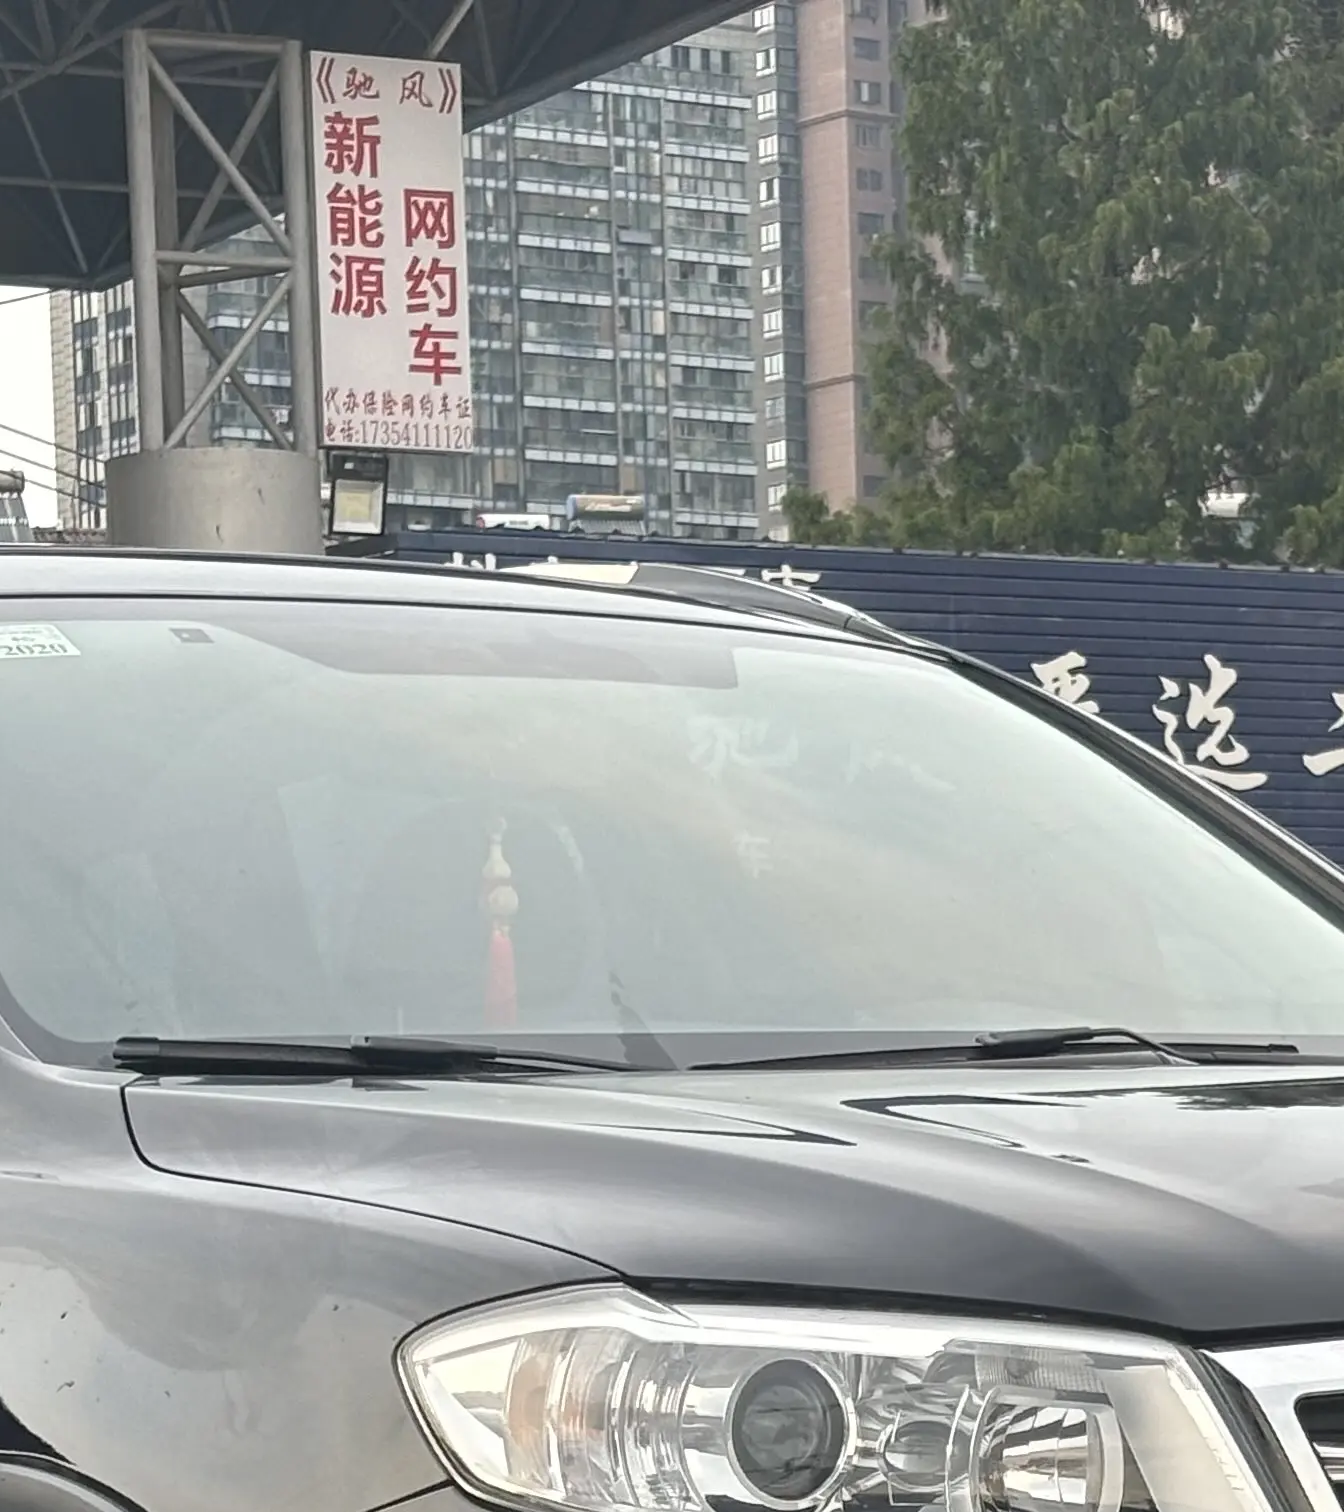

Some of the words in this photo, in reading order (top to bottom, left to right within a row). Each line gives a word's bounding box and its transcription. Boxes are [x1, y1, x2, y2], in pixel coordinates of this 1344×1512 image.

[323, 110, 386, 319] 新能源
[403, 187, 462, 387] 网约车
